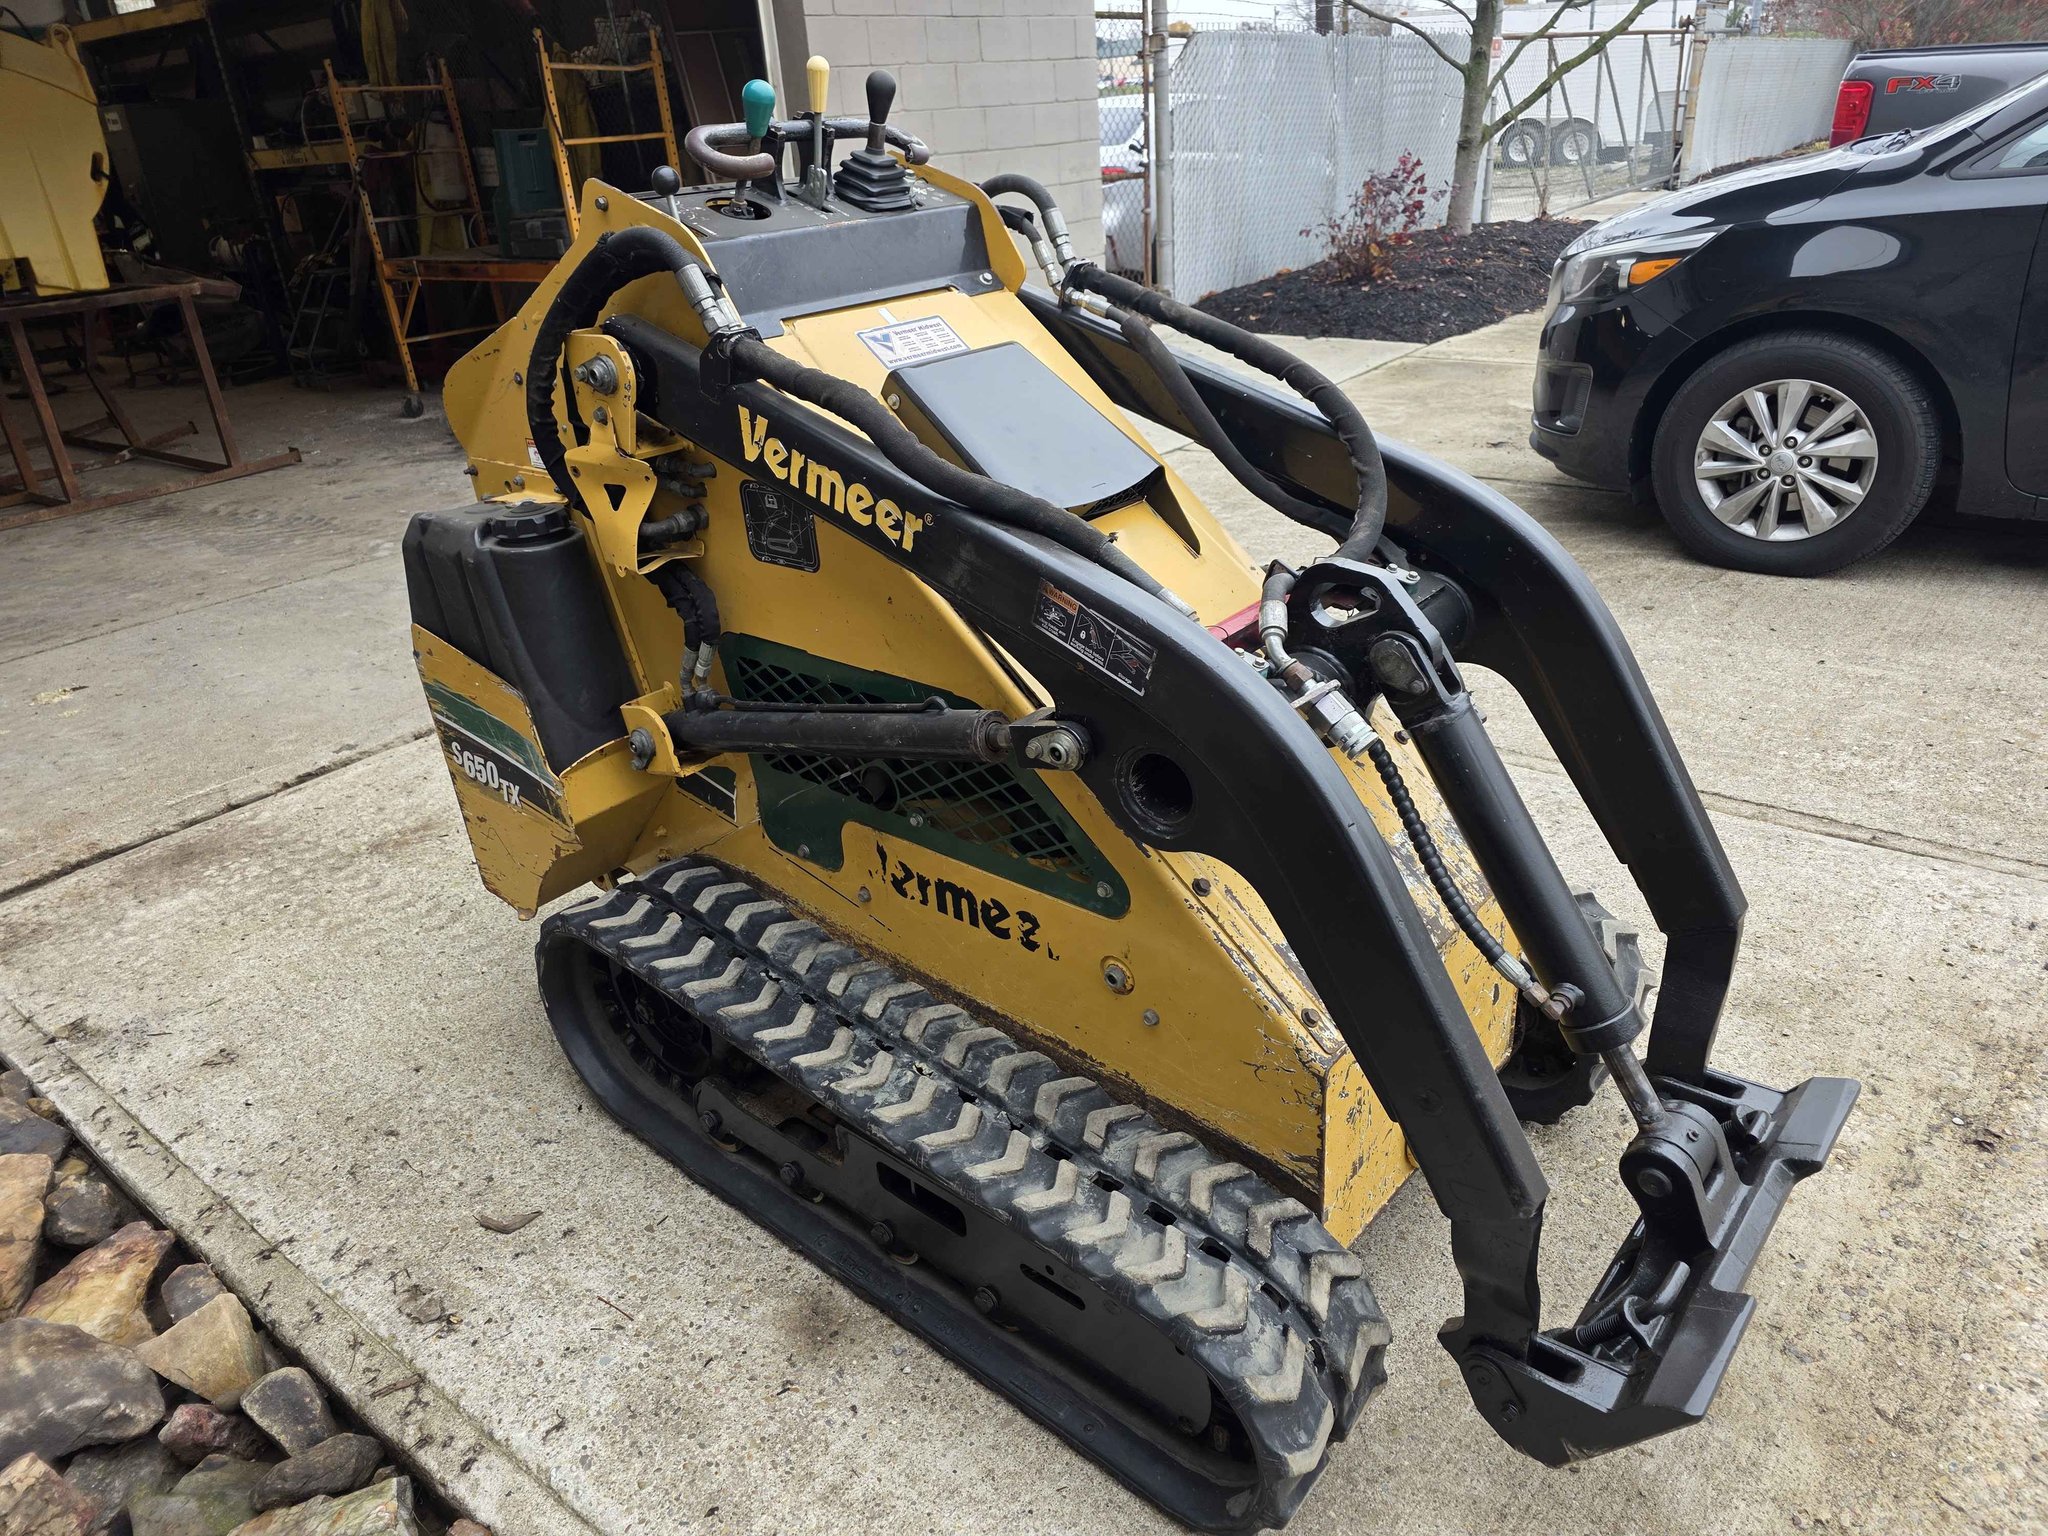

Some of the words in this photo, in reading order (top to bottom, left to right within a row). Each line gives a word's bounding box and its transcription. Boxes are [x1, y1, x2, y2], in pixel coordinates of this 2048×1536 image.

[1885, 74, 1961, 94] FX4
[892, 328, 917, 336] Vermeer
[919, 322, 942, 331] Midwest
[1050, 590, 1077, 611] WARNING
[451, 741, 522, 808] S650TX
